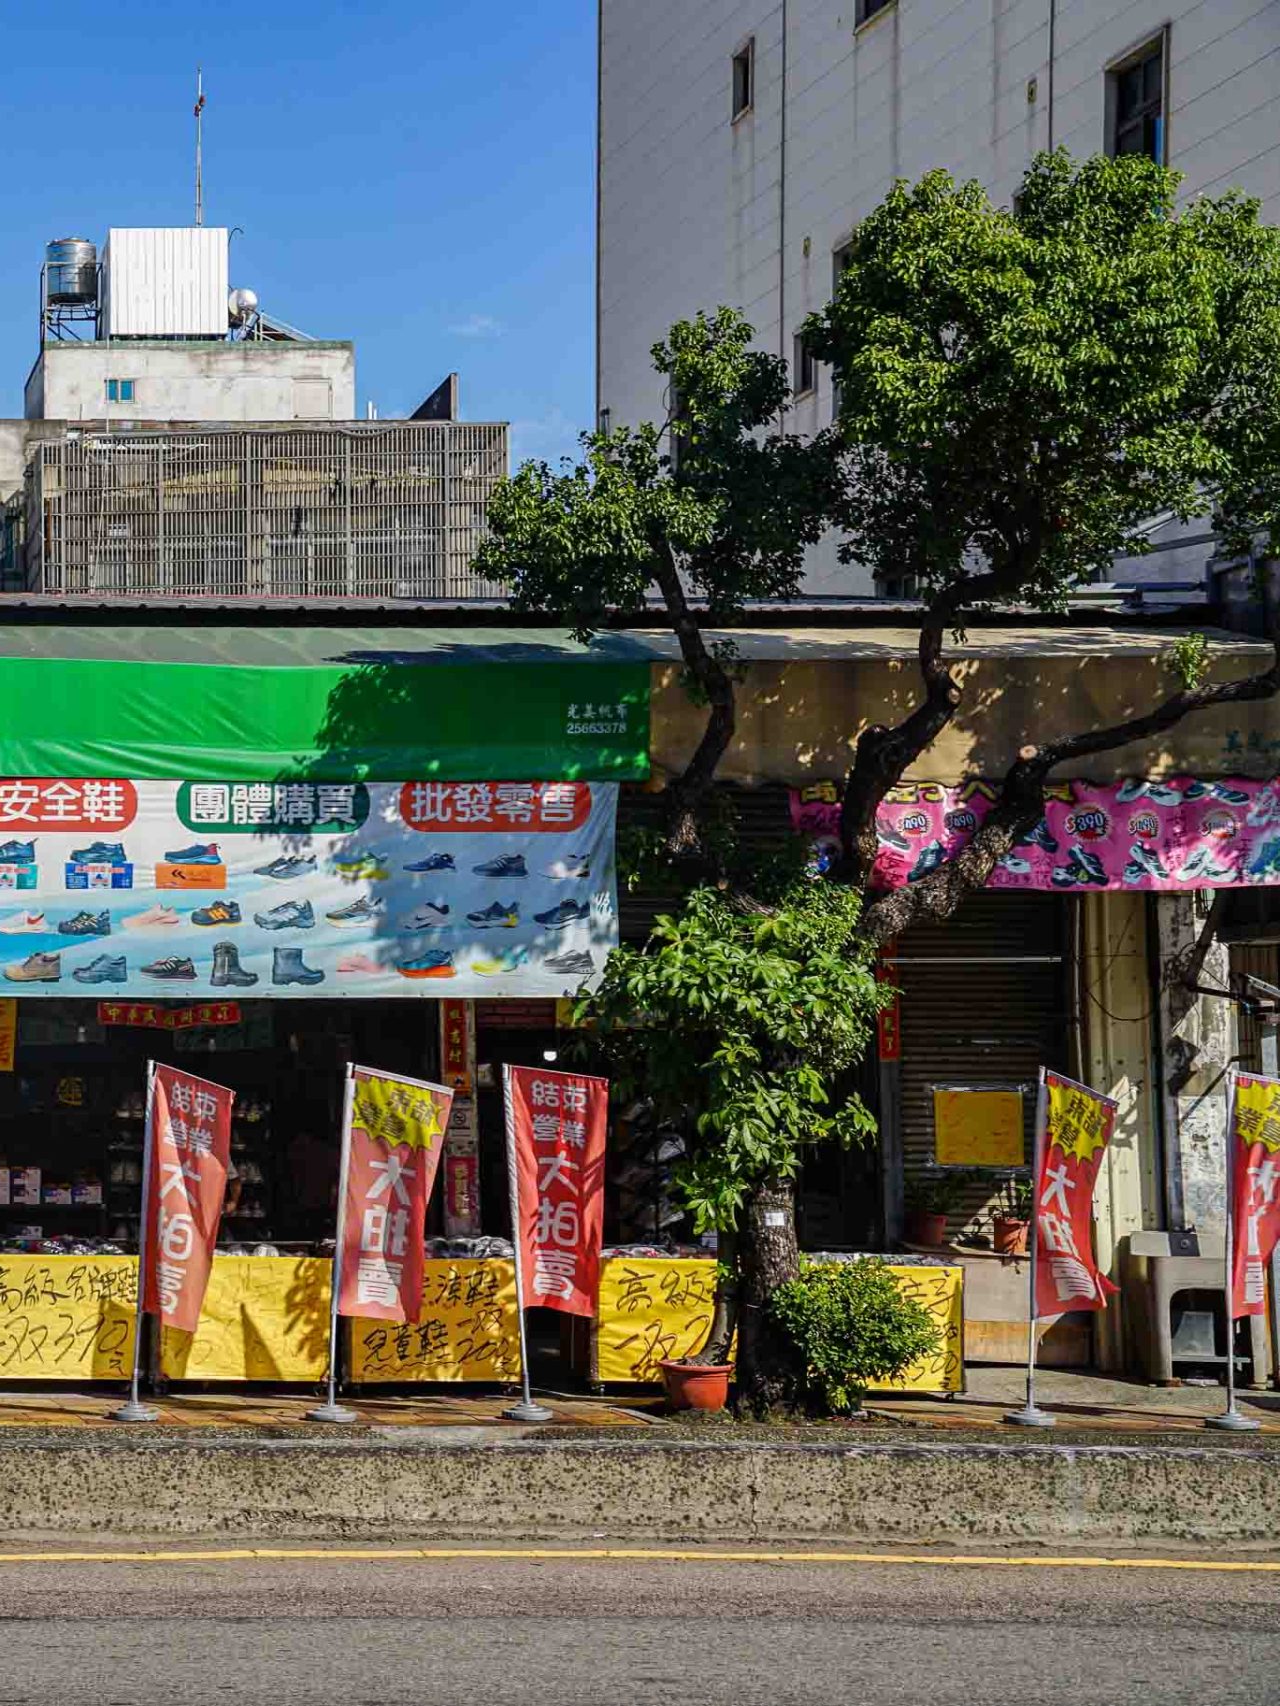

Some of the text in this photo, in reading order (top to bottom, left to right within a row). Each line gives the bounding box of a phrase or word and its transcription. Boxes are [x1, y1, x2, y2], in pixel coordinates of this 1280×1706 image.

[567, 723, 626, 734] 25663378
[190, 783, 357, 825] 團體購買
[410, 783, 577, 823] 批發零售
[530, 1079, 587, 1115] 結束
[531, 1113, 587, 1150] 營業
[533, 1150, 580, 1301] 大拍賣
